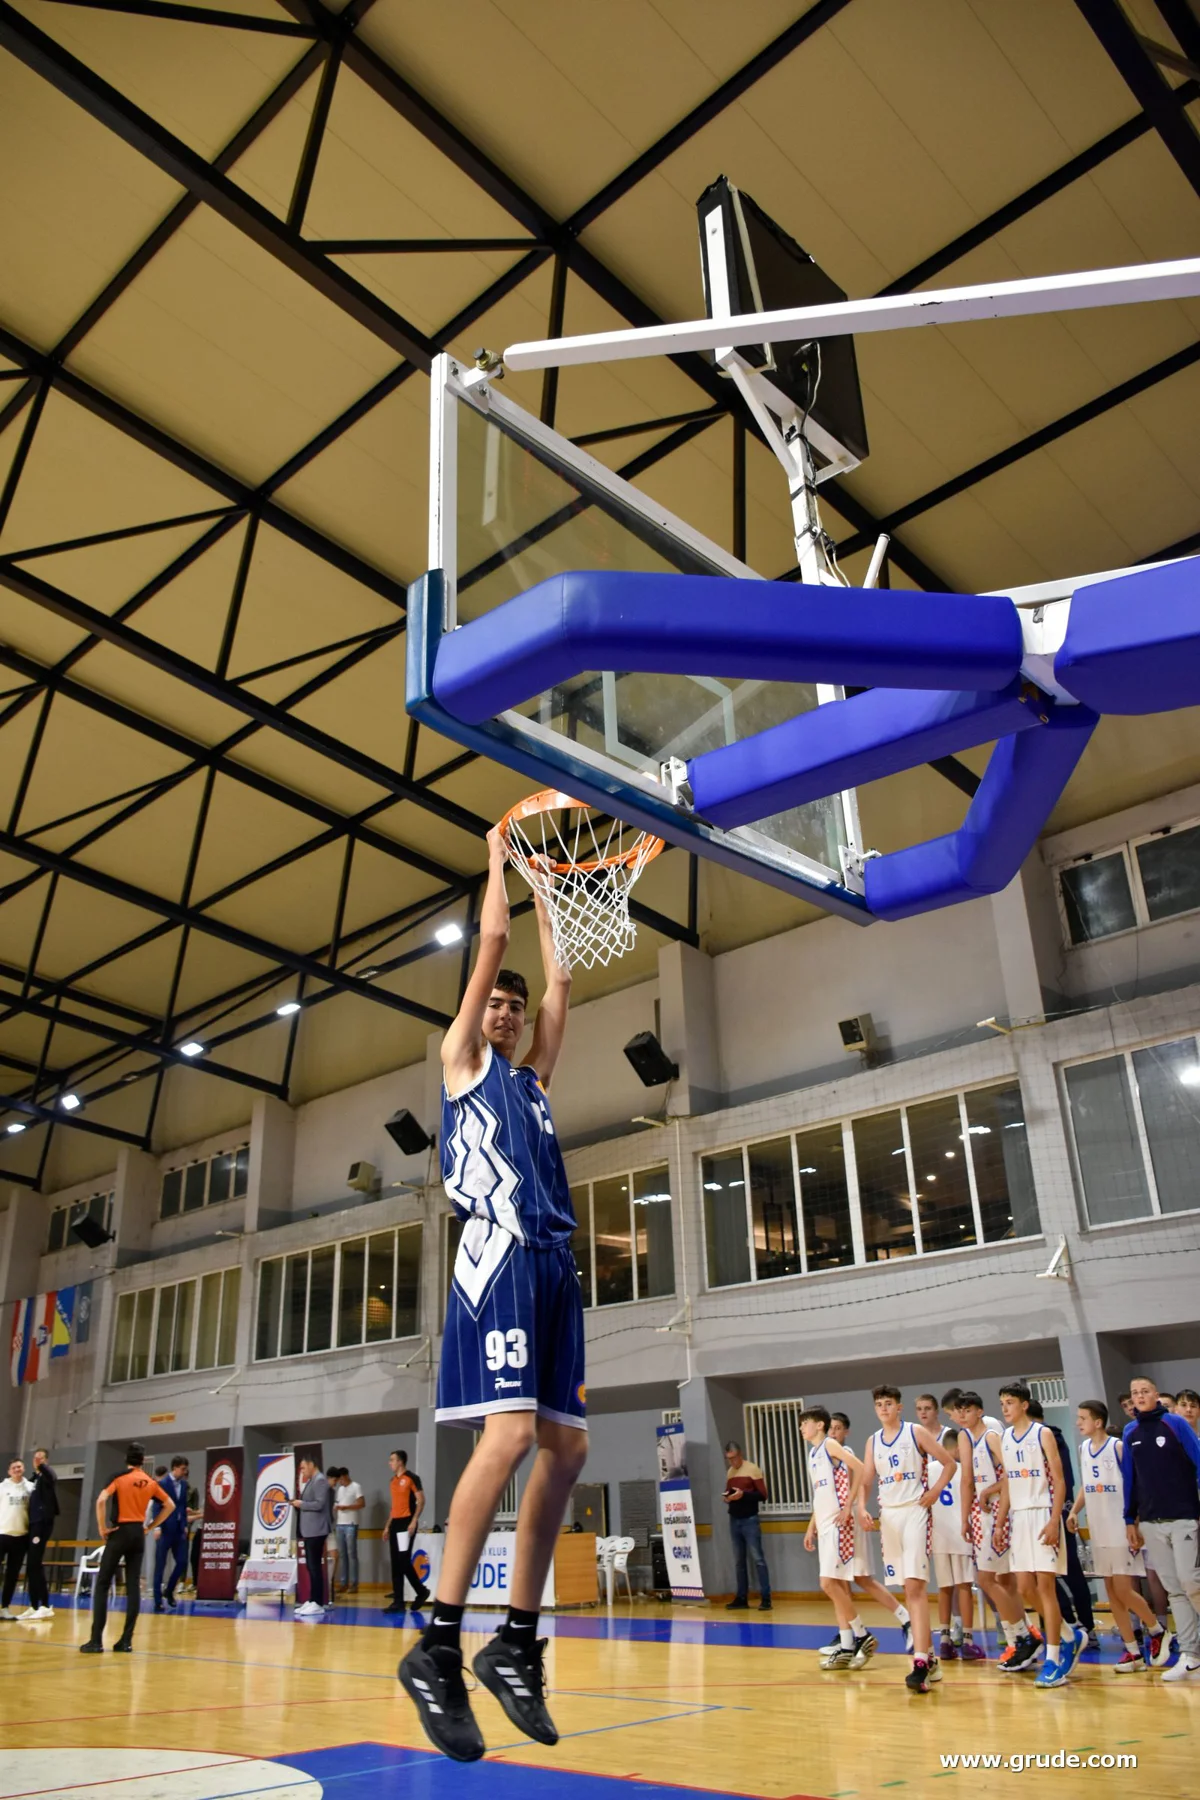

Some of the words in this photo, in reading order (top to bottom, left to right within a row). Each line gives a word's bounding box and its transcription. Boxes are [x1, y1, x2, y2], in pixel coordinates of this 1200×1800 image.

[485, 1328, 528, 1370] 93
[889, 1455, 899, 1468] 16
[1016, 1450, 1024, 1462] 11
[1092, 1466, 1099, 1478] 5
[488, 1547, 507, 1556] KLUB
[470, 1563, 507, 1589] UDE
